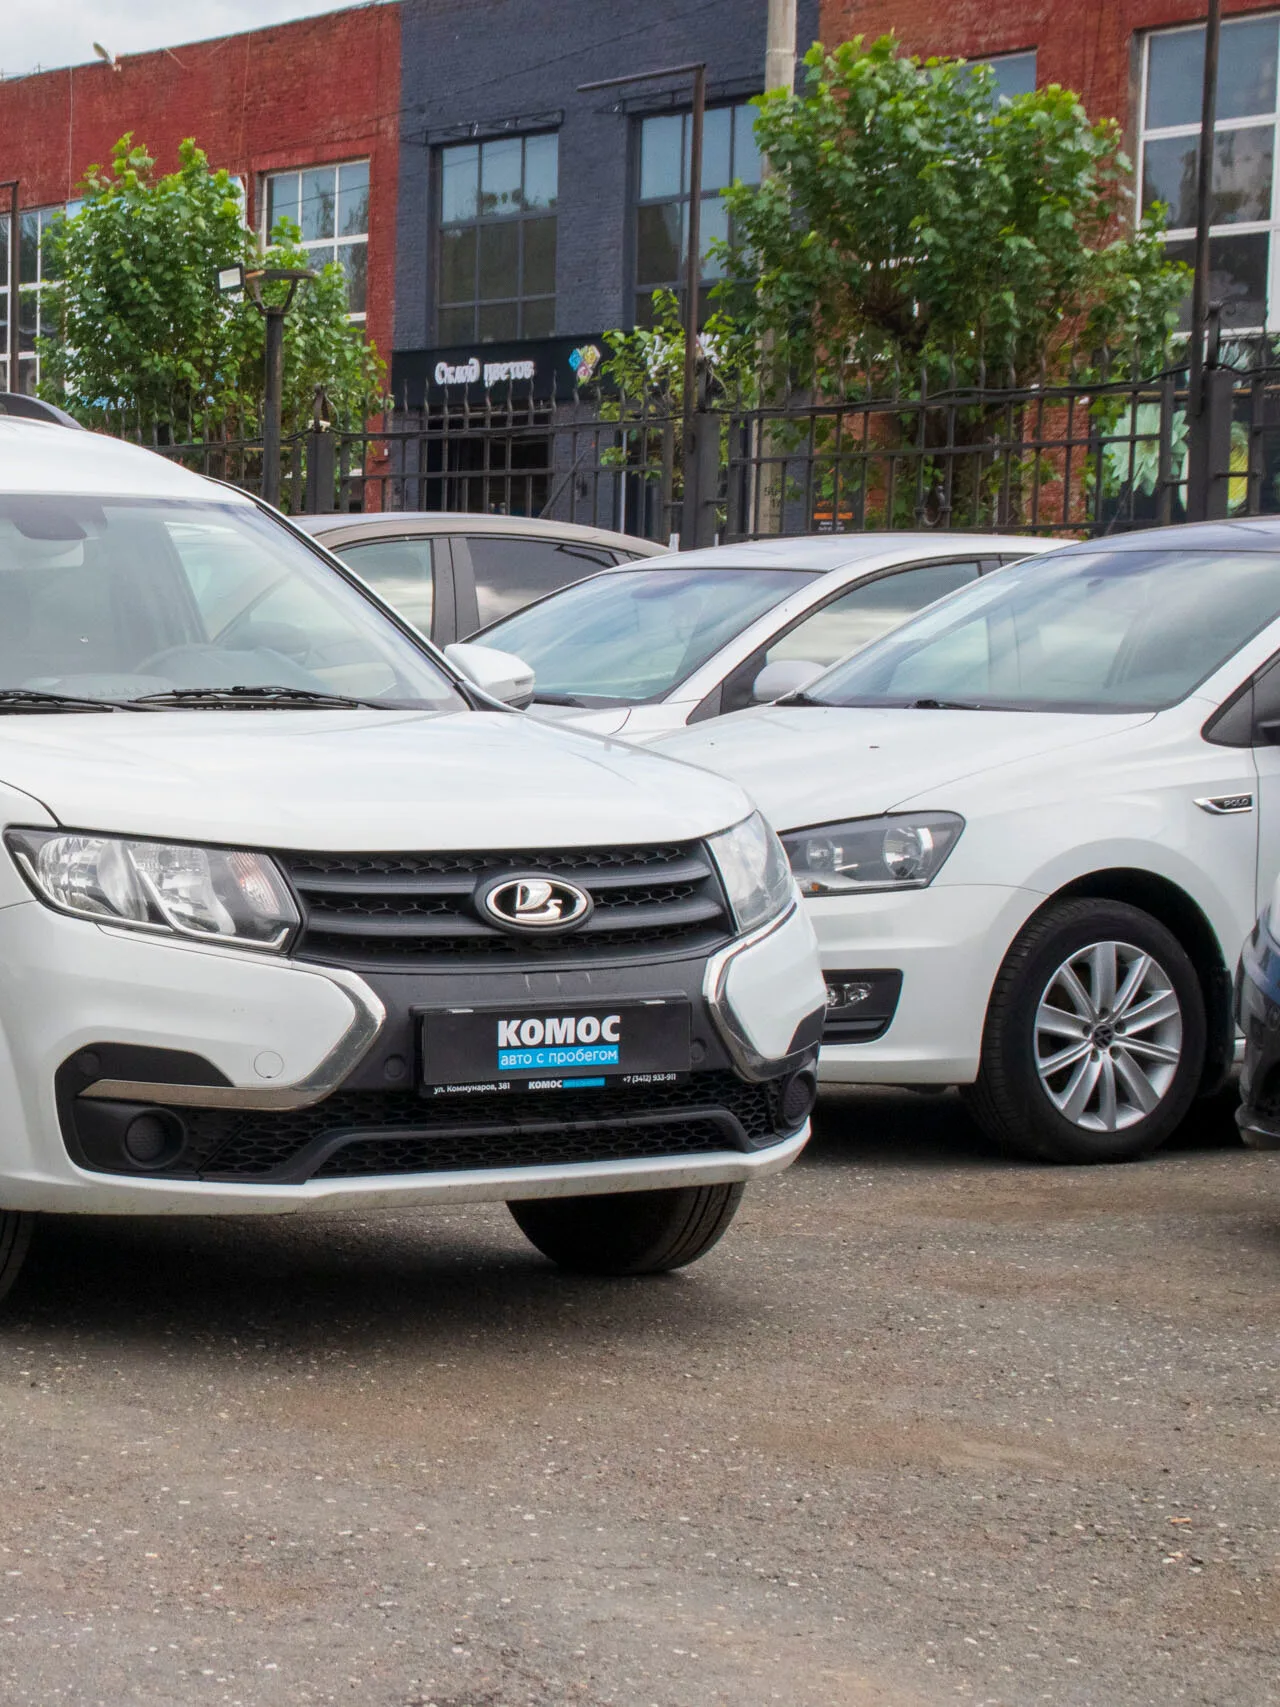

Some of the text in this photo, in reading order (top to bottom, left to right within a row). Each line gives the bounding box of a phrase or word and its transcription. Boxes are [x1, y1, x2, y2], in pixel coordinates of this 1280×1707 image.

[484, 361, 535, 388] цветов
[497, 1015, 621, 1047] КОМОС
[501, 1048, 618, 1066] авто с пробегом
[446, 1083, 497, 1094] Коммунаров,
[498, 1082, 511, 1091] 381
[528, 1079, 563, 1090] КОМОС
